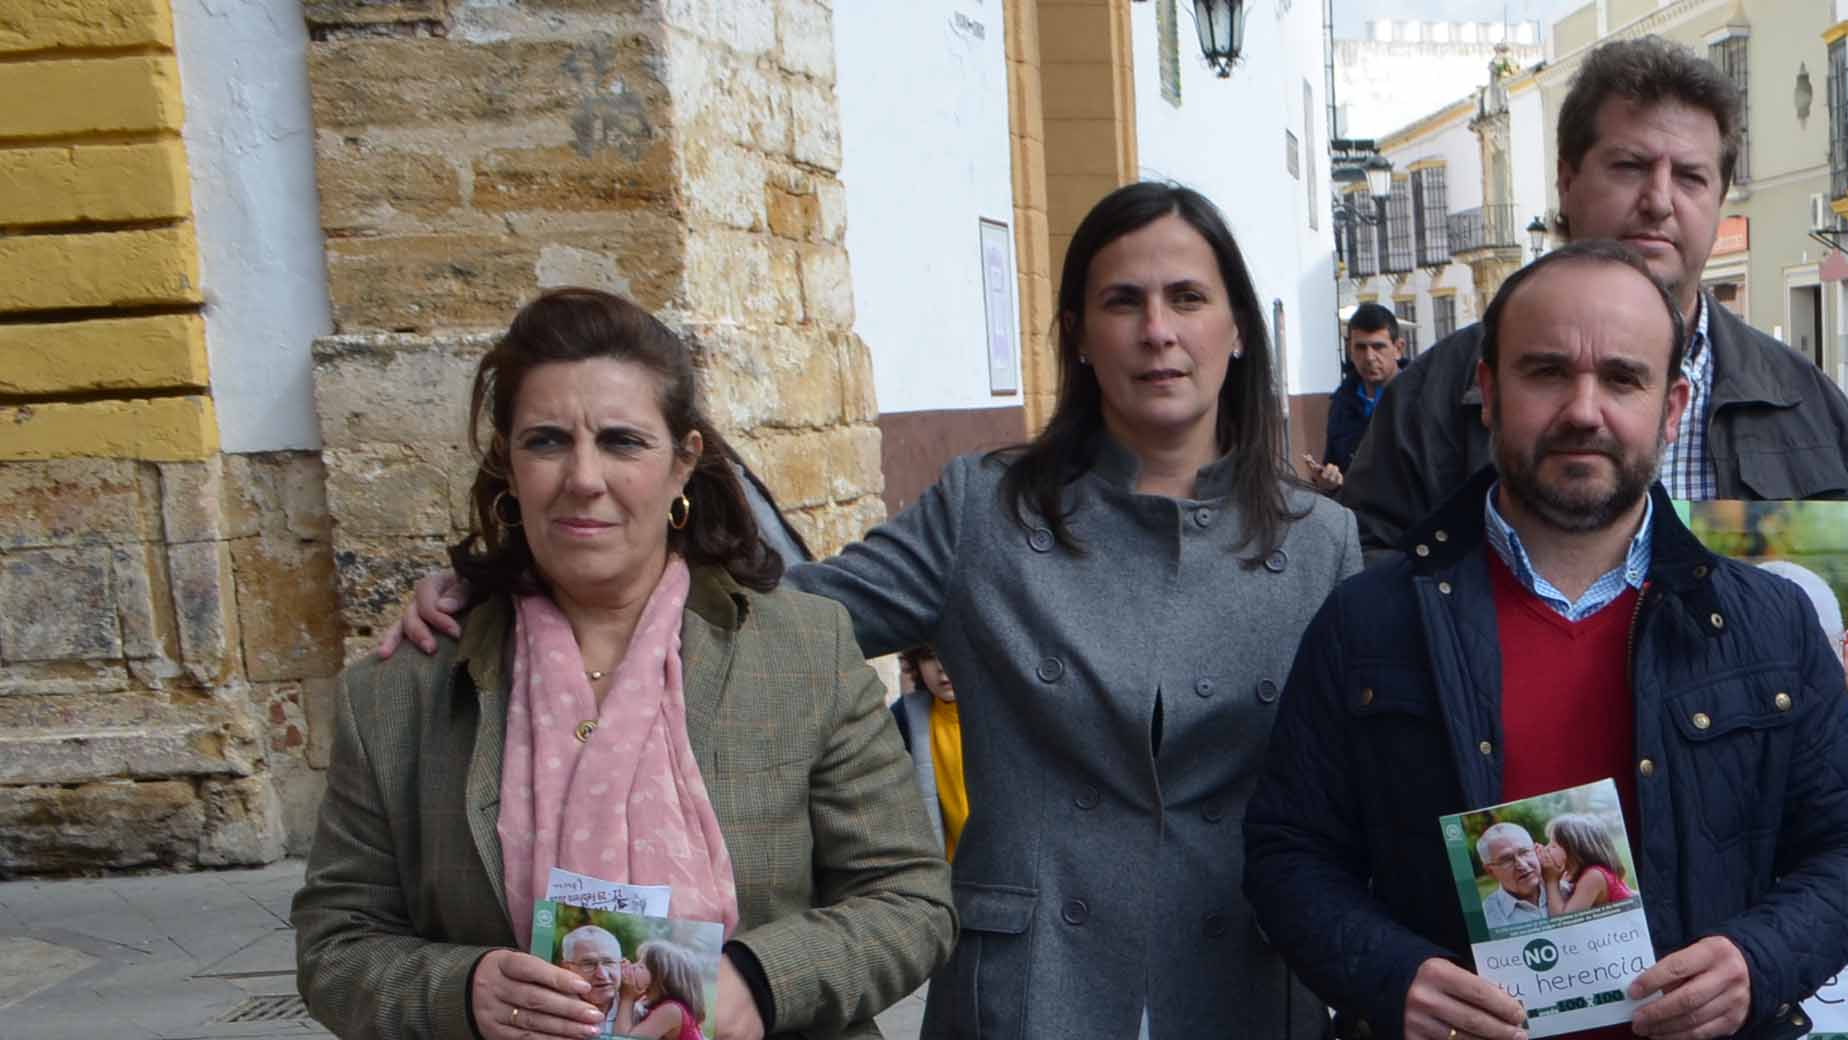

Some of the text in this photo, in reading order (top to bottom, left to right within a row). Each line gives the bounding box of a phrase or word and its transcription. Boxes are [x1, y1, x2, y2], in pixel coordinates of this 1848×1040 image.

[1486, 928, 1640, 971] Que NO te quiten
[1536, 955, 1647, 994] herencia
